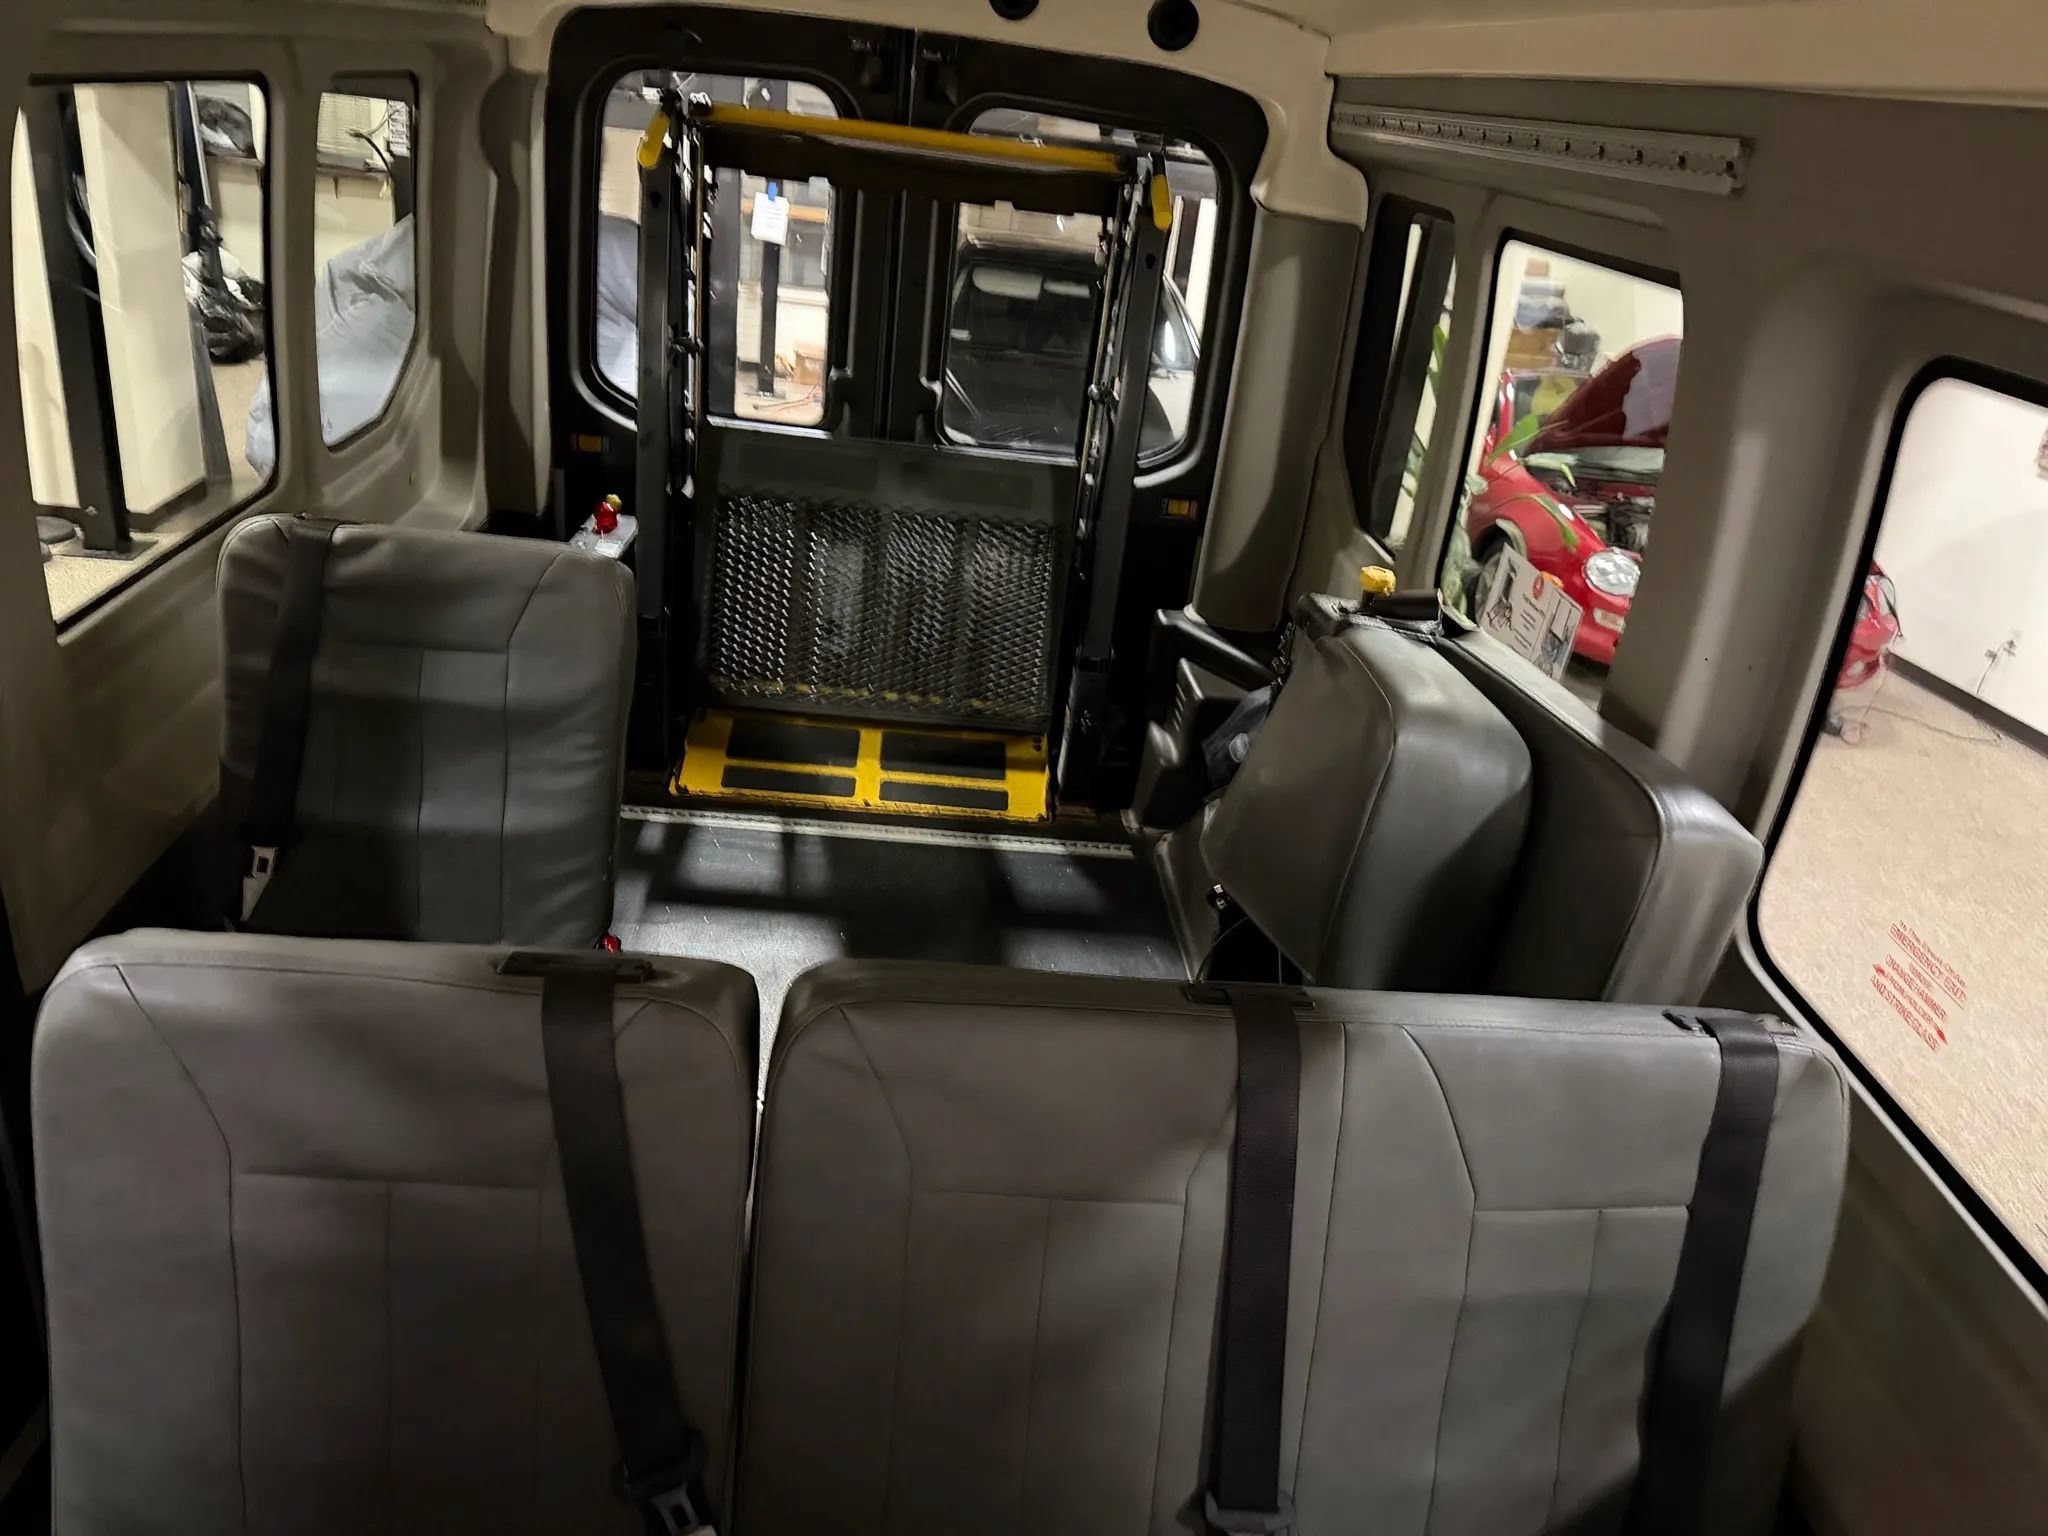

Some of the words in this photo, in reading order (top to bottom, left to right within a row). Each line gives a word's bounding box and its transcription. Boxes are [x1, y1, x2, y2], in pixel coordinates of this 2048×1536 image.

[1885, 954, 1916, 990] ORANGE
[1914, 984, 1948, 1020] HAMMER
[1889, 922, 1943, 979] EMERGENCY
[1943, 975, 1967, 1003] EXIT
[1870, 974, 1886, 995] AND
[1881, 989, 1914, 1026] STRIKE
[1910, 1017, 1940, 1051] GLASS
